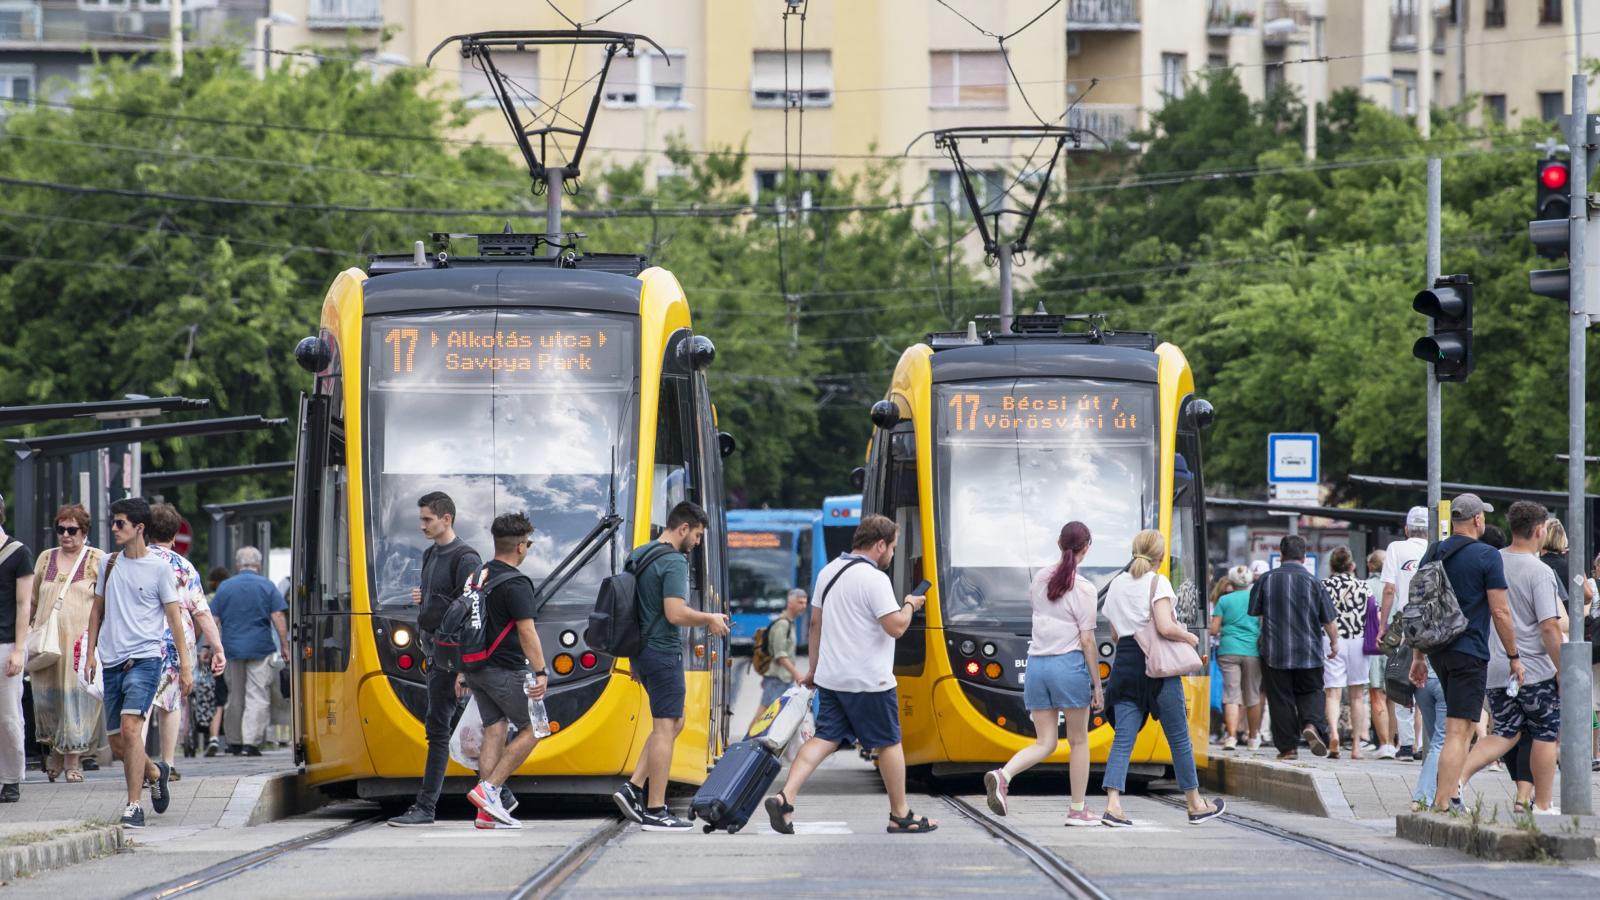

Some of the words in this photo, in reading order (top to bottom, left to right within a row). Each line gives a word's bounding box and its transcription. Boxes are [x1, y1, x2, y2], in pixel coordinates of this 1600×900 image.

[447, 331, 532, 348] Alkotás
[539, 331, 592, 348] utca
[385, 328, 418, 372] 17
[445, 353, 531, 372] Savoya
[538, 353, 592, 370] Park
[1002, 396, 1066, 410] Bécsi
[1078, 395, 1100, 410] út
[950, 394, 980, 431] 17
[984, 413, 1103, 429] Vörösvári
[1114, 412, 1136, 429] út
